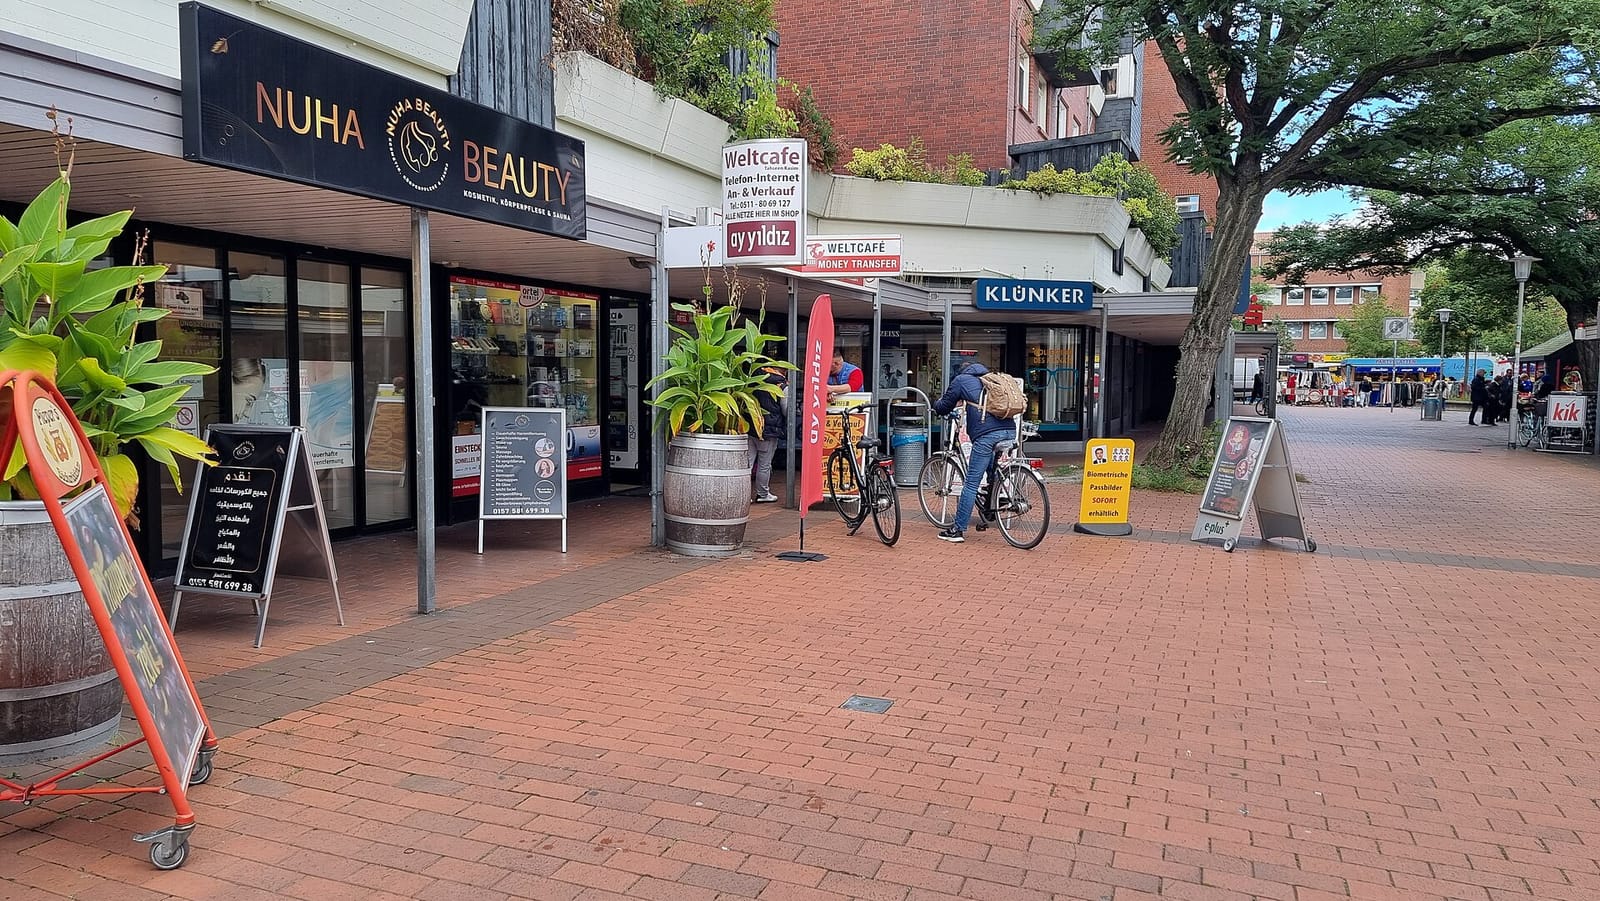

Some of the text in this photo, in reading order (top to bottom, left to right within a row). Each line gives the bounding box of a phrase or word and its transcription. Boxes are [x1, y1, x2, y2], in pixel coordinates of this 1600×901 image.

[256, 81, 365, 150] NUHA
[386, 98, 451, 151] NUHA BEAUTY
[725, 147, 800, 169] Weltcafe
[463, 140, 572, 206] BEAUTY
[725, 173, 800, 186] Telefon-Internet
[727, 185, 795, 199] An- & Verkauf
[463, 189, 499, 205] KOSMETIK,
[500, 198, 546, 216] KÖRPERPFLEGE
[552, 211, 572, 221] SAUNA
[740, 200, 754, 209] 0511
[759, 200, 767, 208] 80
[768, 200, 777, 208] 69
[779, 200, 791, 208] 127
[736, 211, 754, 219] NETZE
[755, 210, 771, 218] HIER
[731, 232, 745, 253] ay
[828, 240, 886, 253] WELTCAFÉ
[817, 259, 897, 269] MONEY TRANSFER
[985, 285, 1085, 304] KLÜNKER
[1553, 402, 1580, 422] kik
[810, 413, 820, 444] ay
[313, 458, 344, 466] rentfernung
[224, 581, 240, 591] 699
[241, 582, 253, 592] 38
